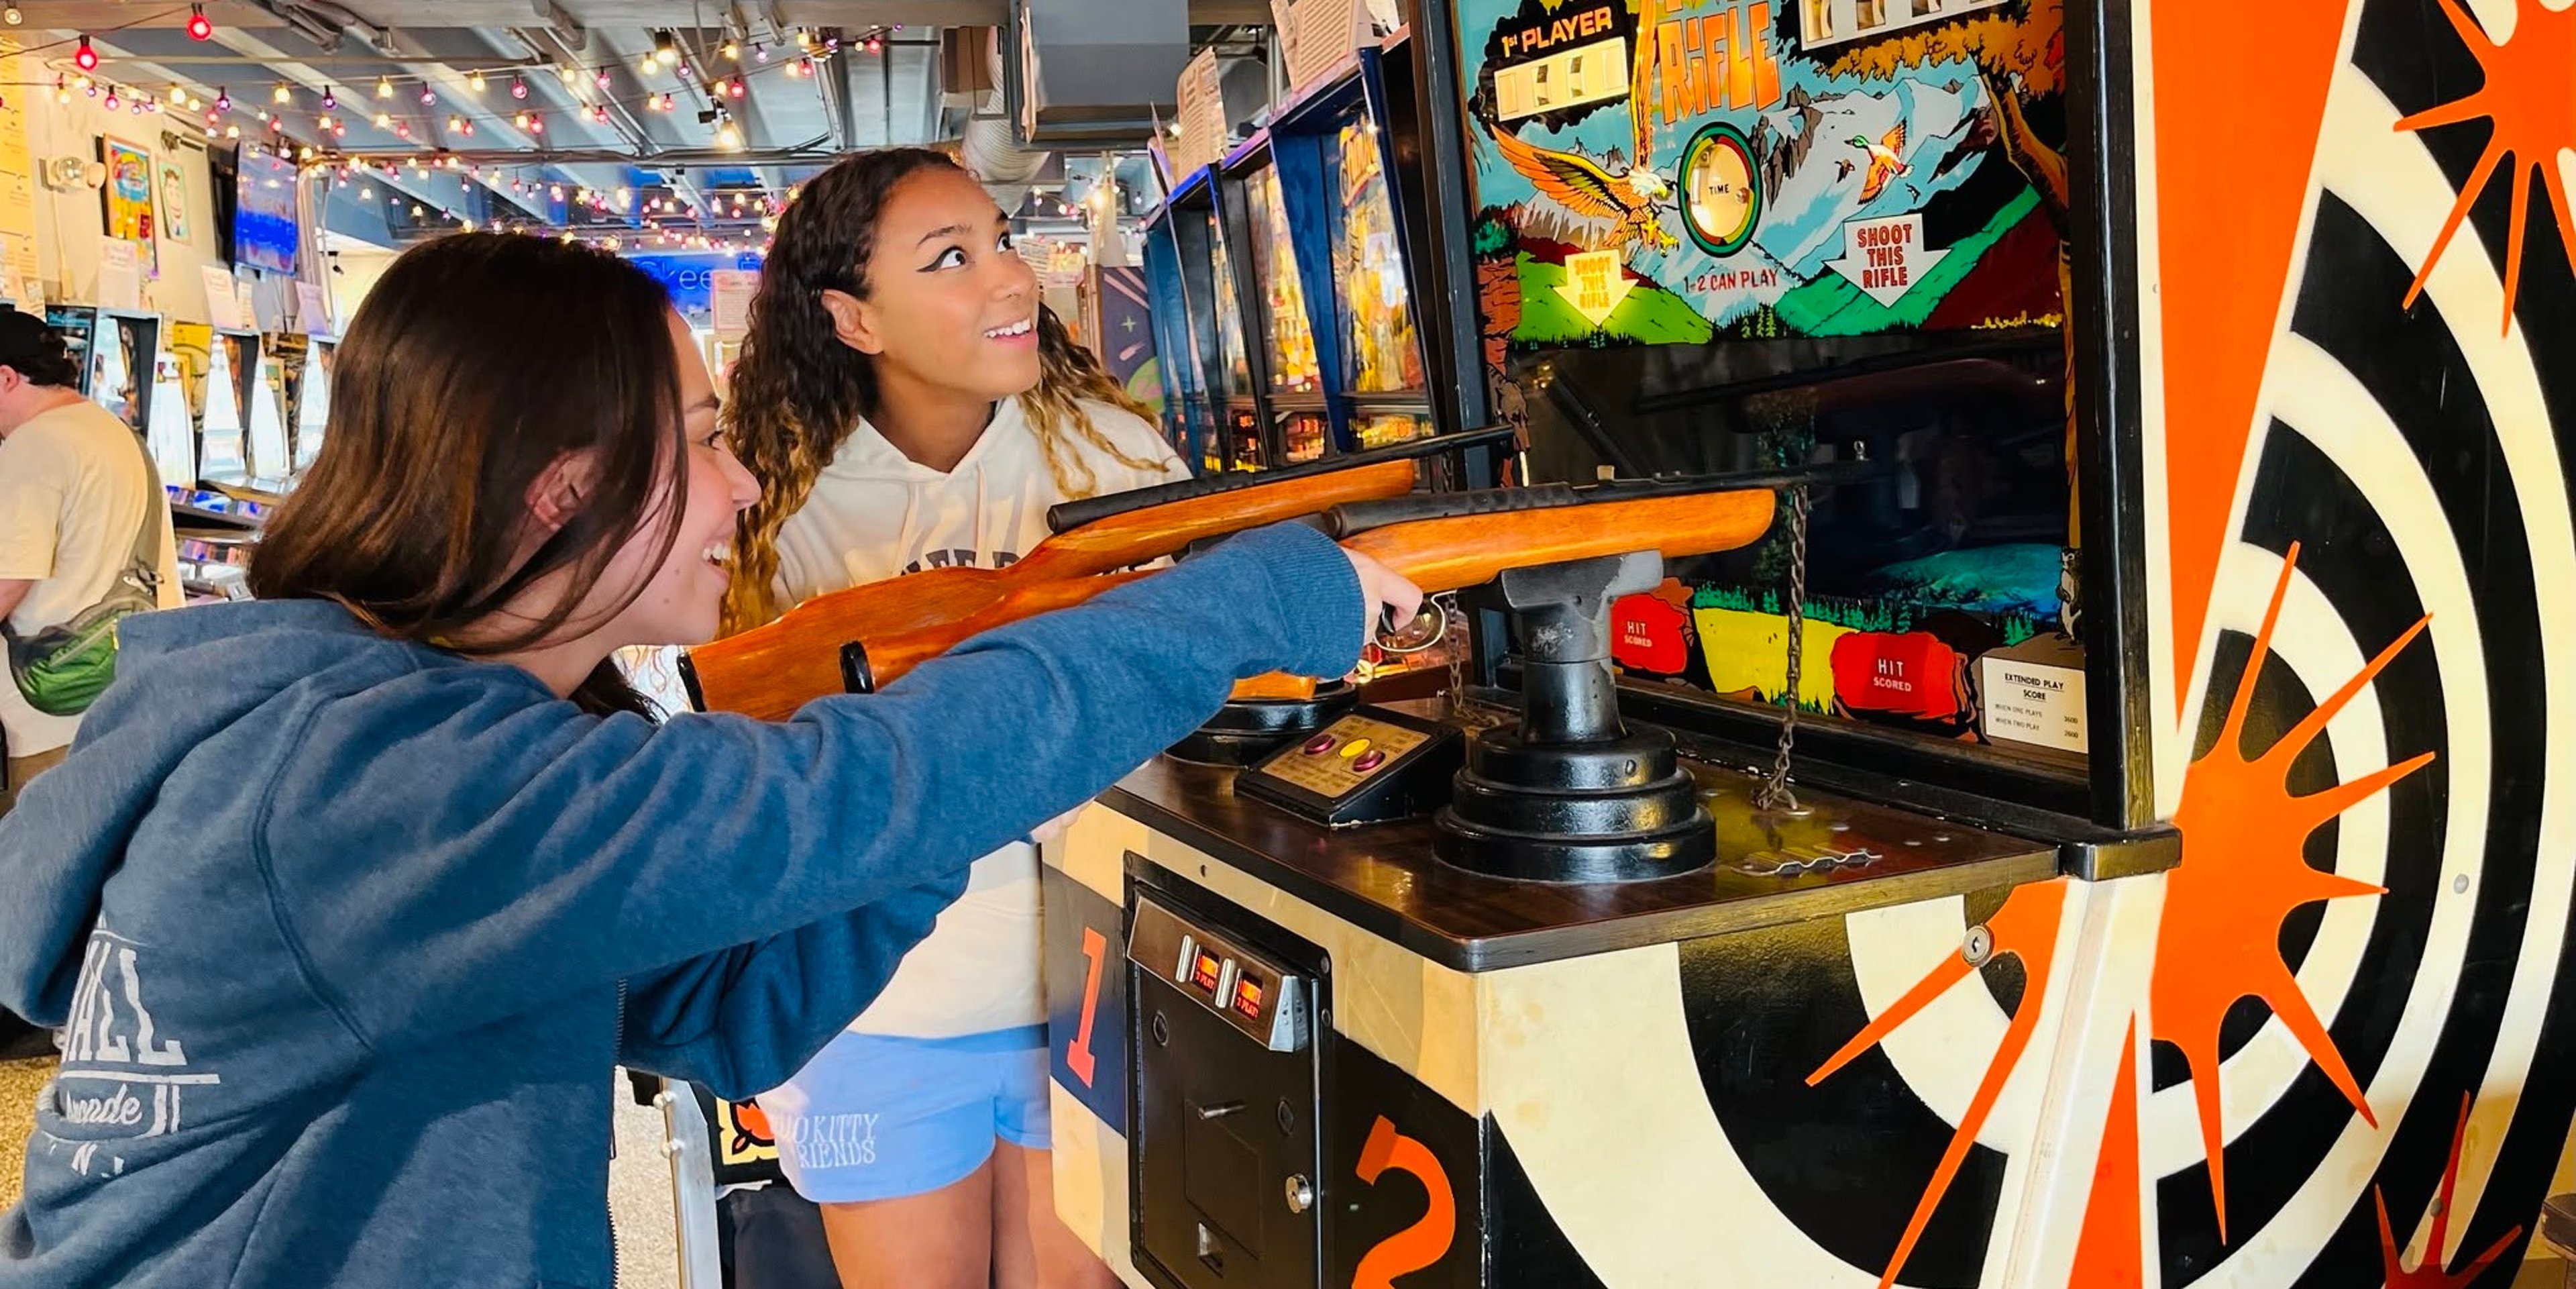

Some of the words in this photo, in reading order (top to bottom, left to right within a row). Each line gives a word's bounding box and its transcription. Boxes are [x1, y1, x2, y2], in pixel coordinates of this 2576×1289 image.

[1501, 34, 1518, 58] 1st
[1521, 6, 1613, 53] PLAYER
[1709, 183, 1729, 195] TIME
[1857, 223, 1912, 248] SHOOT
[1867, 246, 1904, 267] THIS
[1683, 274, 1707, 293] 1-2
[1711, 271, 1736, 291] CAN
[1740, 268, 1778, 289] PLAY
[1862, 266, 1908, 289] RIFLE
[1627, 621, 1647, 636] HIT
[1623, 634, 1653, 648] SCORED
[1878, 658, 1904, 677] HIT
[1873, 676, 1912, 692] SCORED
[2004, 673, 2041, 686] EXTENDED
[2043, 680, 2064, 690] PLAY
[2023, 689, 2046, 701] SCORE
[1067, 926, 1106, 1088] 1
[814, 1113, 880, 1143] KITTY
[796, 1139, 876, 1170] RIENDS
[1350, 1114, 1456, 1289] 2
